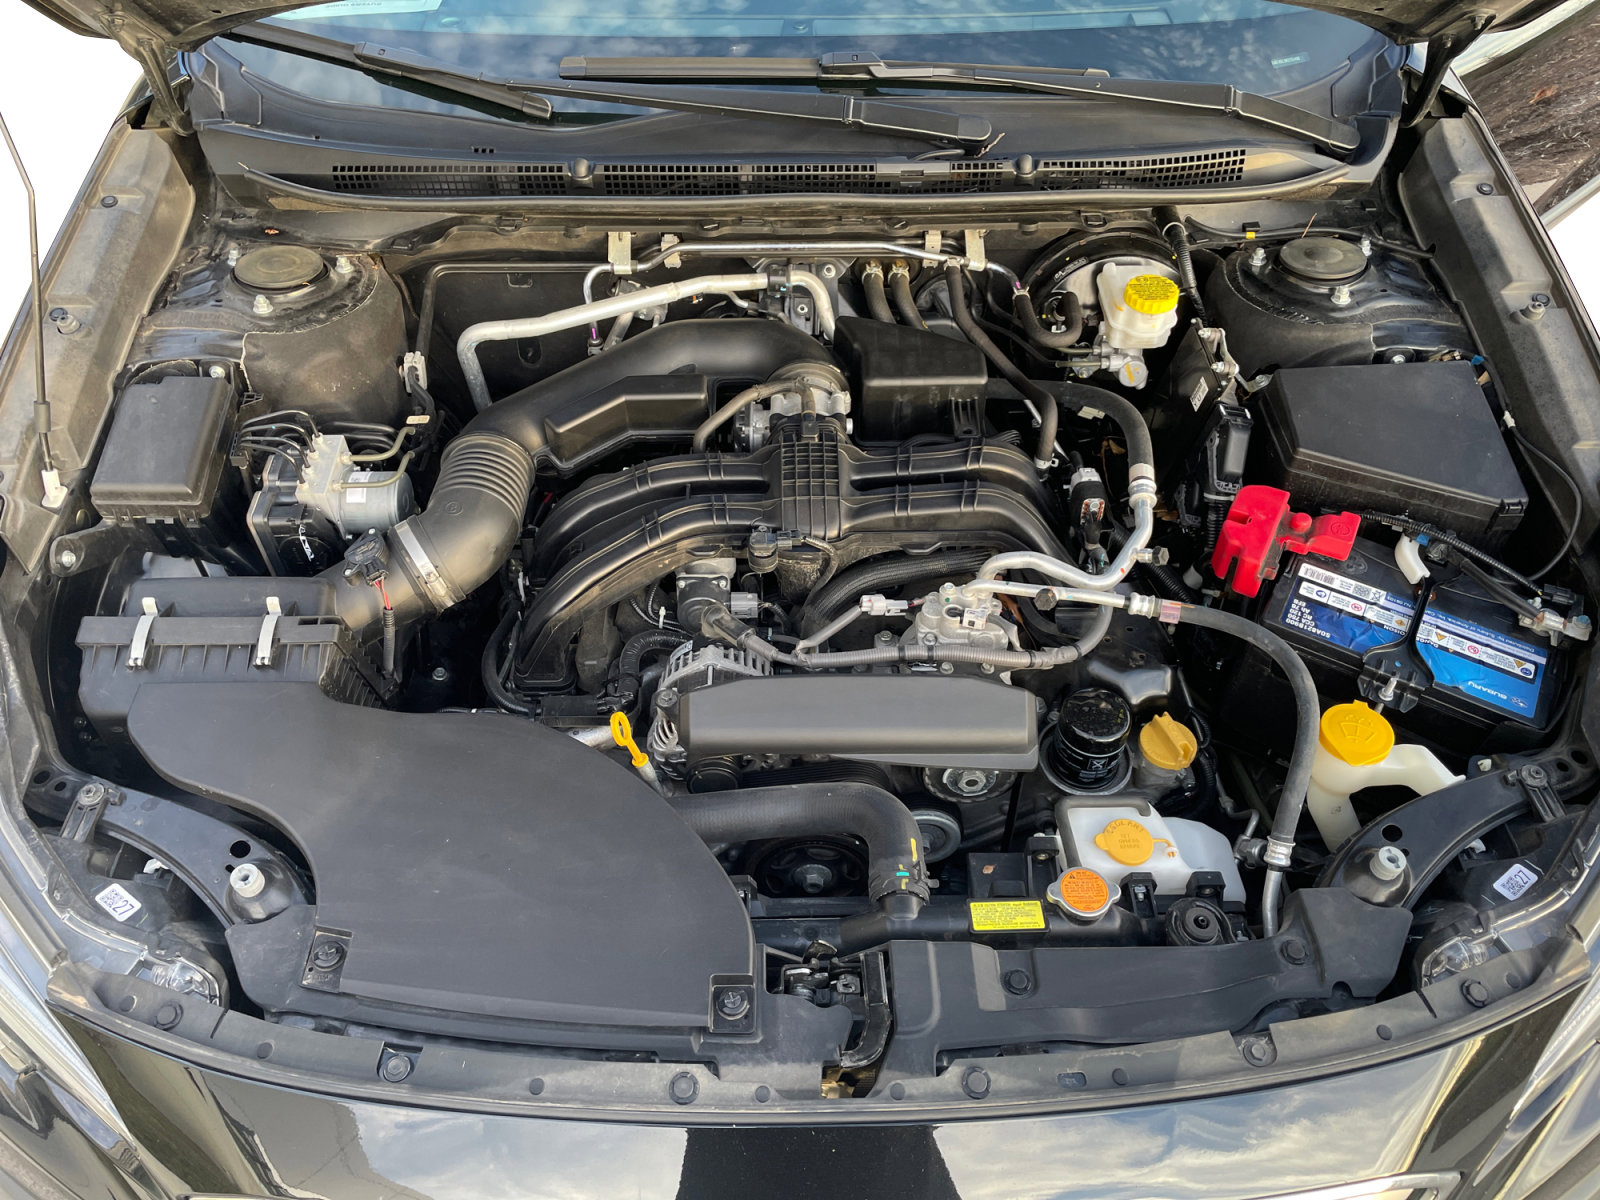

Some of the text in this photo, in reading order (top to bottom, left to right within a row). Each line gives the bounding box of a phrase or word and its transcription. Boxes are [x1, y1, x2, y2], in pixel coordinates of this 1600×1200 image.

[1301, 618, 1315, 627] CCA
[1383, 625, 1406, 636] OISON
[1415, 636, 1439, 648] DANGE
[1468, 681, 1507, 700] SUBARU
[1514, 869, 1531, 885] 27
[112, 900, 135, 916] 27
